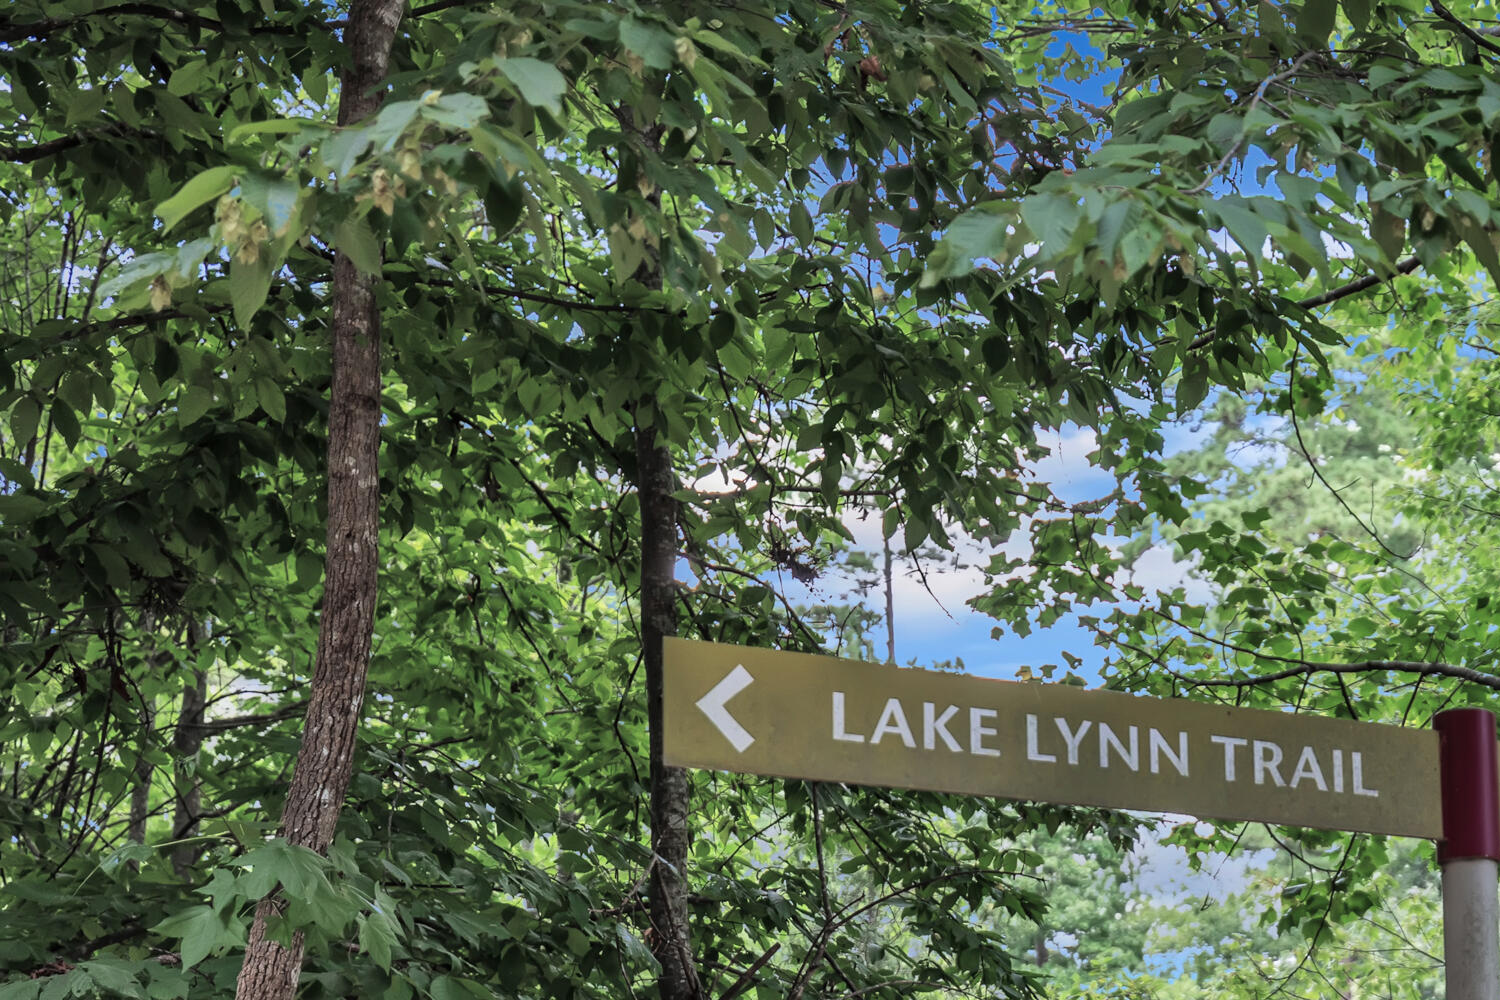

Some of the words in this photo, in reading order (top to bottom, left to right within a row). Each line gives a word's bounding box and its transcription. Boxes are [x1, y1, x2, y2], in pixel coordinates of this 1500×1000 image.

[831, 691, 1001, 757] LAKE
[1025, 713, 1190, 777] LYNN
[1211, 734, 1380, 798] TRAIL
